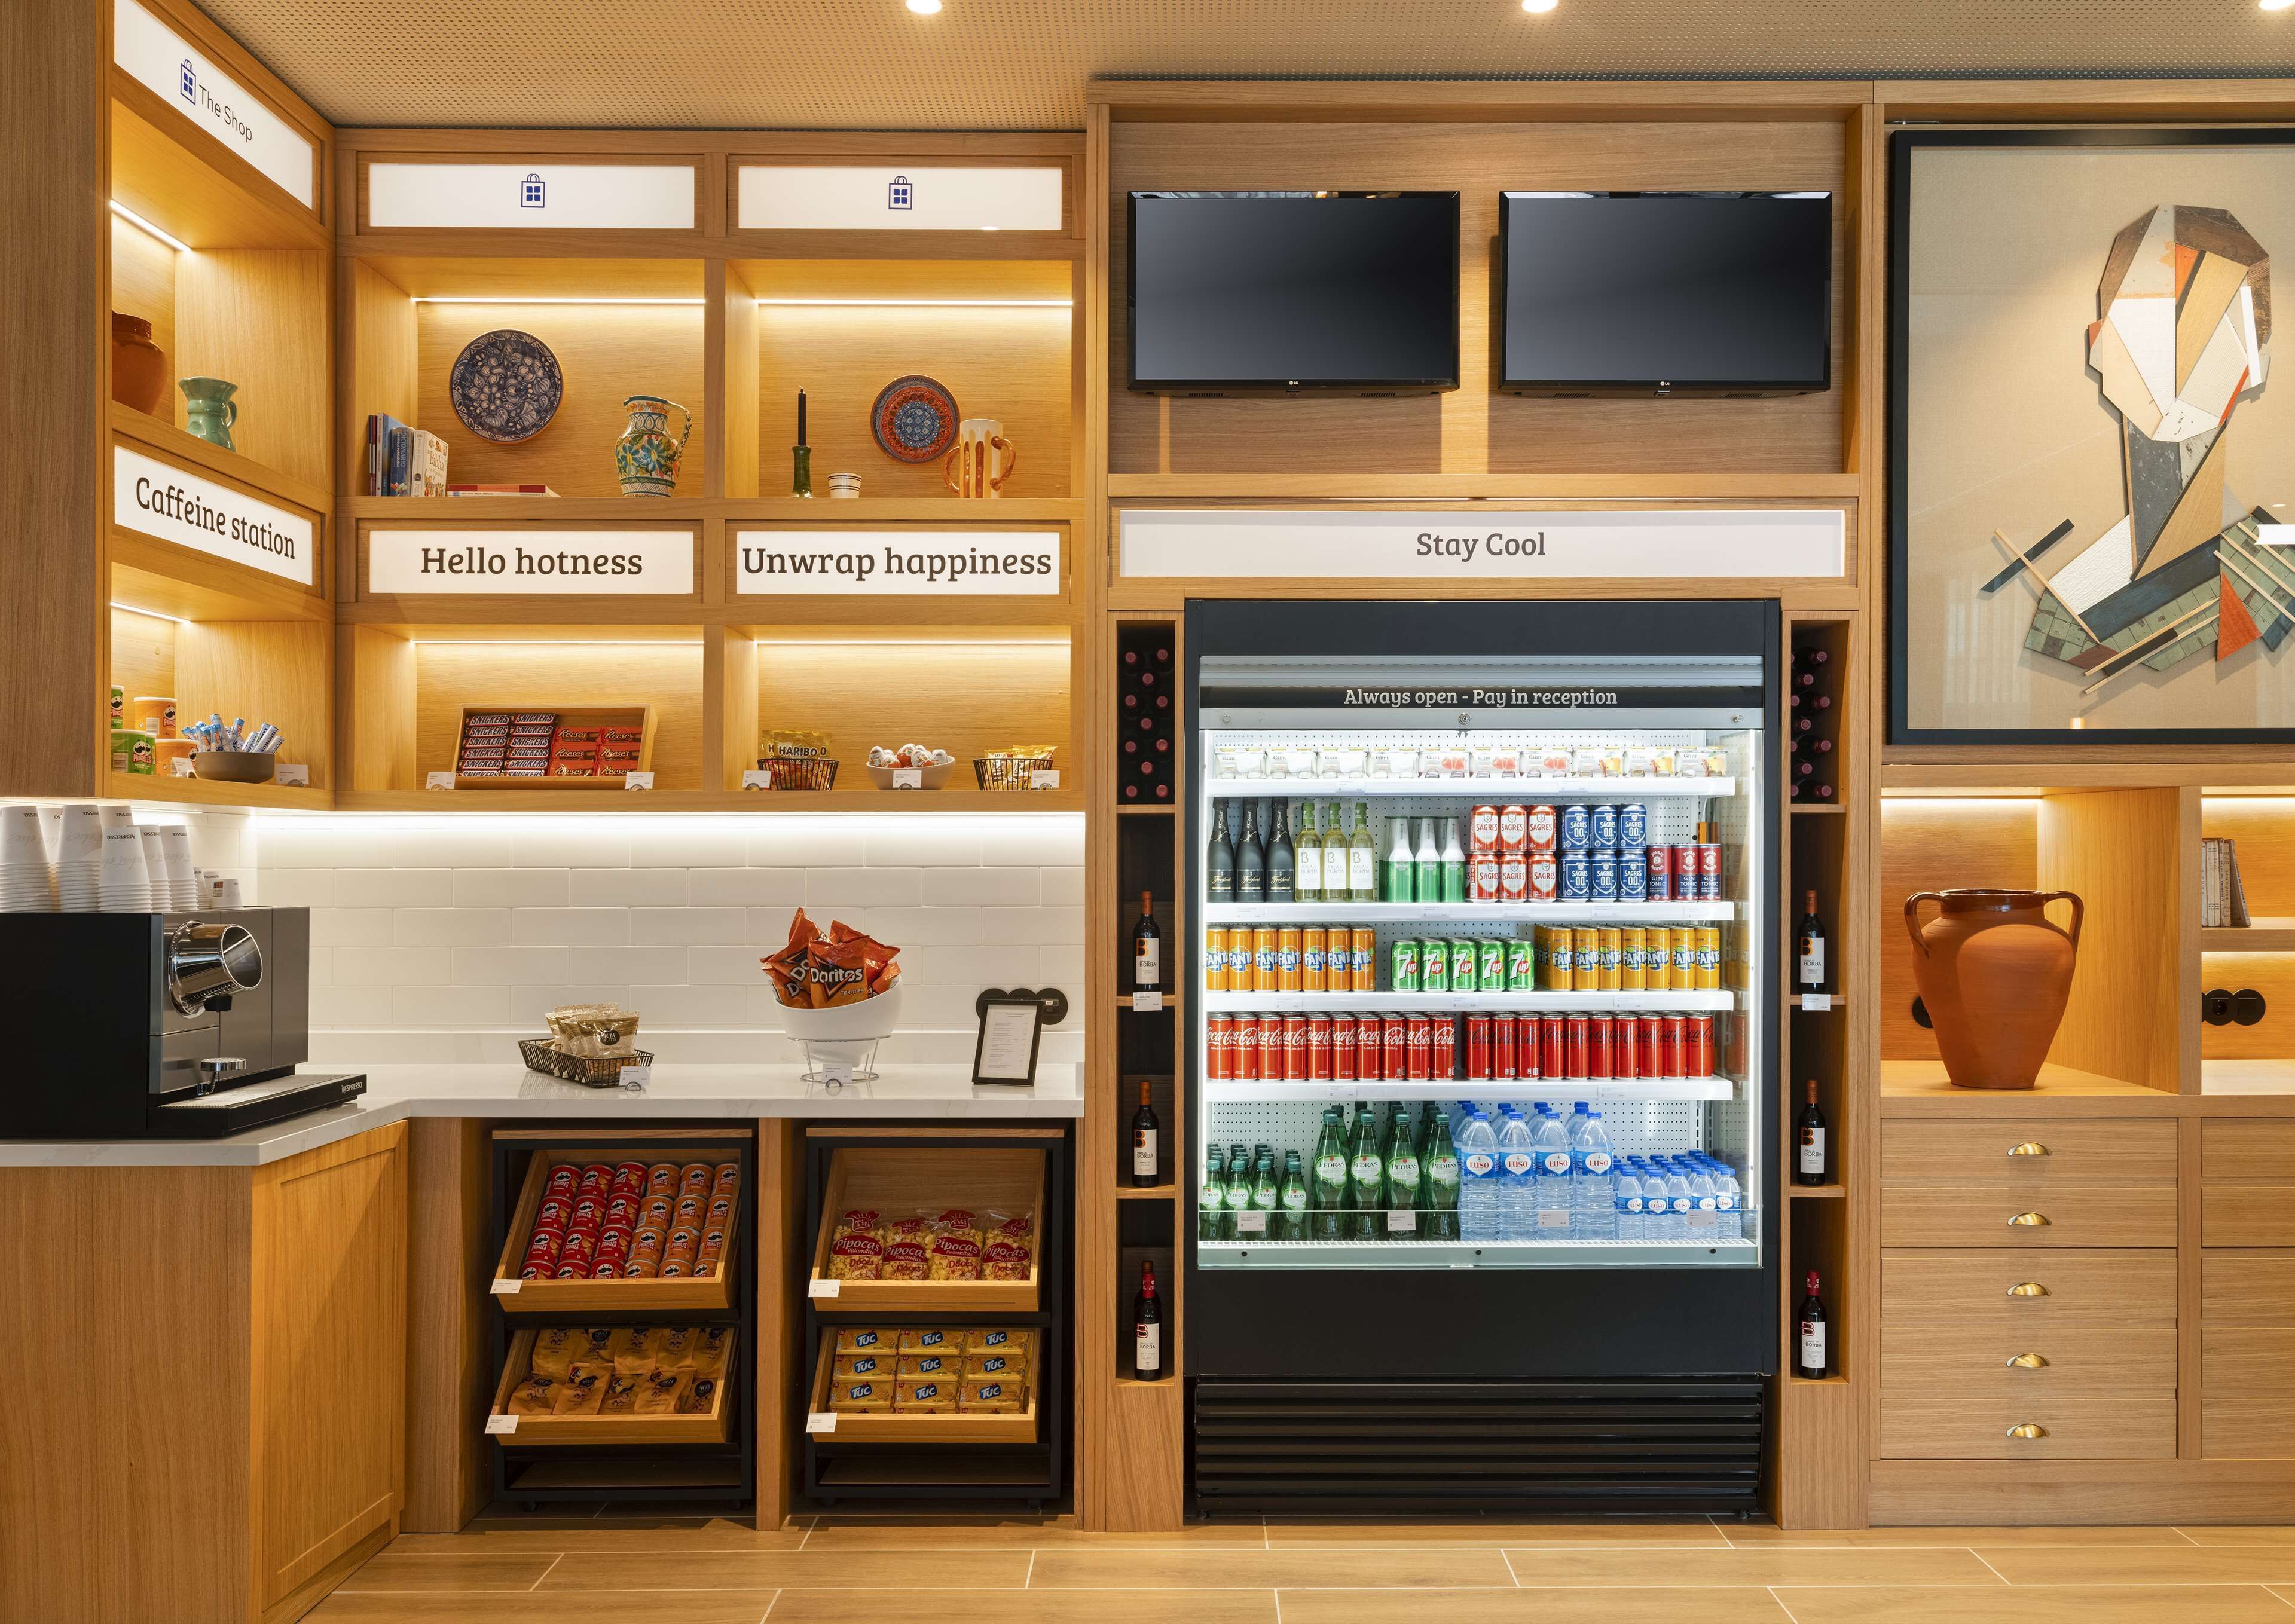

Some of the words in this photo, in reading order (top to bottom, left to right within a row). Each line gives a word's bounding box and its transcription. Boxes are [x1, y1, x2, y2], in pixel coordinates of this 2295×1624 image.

[199, 84, 222, 118] The
[224, 106, 253, 143] Shop
[136, 476, 226, 536] Caffeine
[231, 516, 295, 560] station
[1417, 533, 1479, 562] Stay
[1486, 532, 1545, 556] Cool
[421, 547, 505, 574] Hello
[515, 547, 642, 575] hotness
[743, 548, 875, 581] Unwrap
[884, 547, 1052, 582] happiness
[1344, 689, 1411, 707] Always
[1415, 692, 1457, 707] open
[1472, 690, 1506, 707] Pay
[1511, 689, 1528, 704] in
[1533, 689, 1617, 707] reception
[471, 715, 509, 724] SNICKERS
[517, 714, 554, 723] SNICKERS
[470, 726, 508, 736] SNICKERS
[468, 737, 507, 745] SNICKERS
[511, 737, 549, 746] SNICKERS
[778, 745, 818, 756] HARIBO
[464, 760, 503, 768] SNICKERS
[1534, 871, 1554, 880] SAGRES
[810, 967, 864, 984] Doritos
[341, 1082, 362, 1093] NESPRESSO
[837, 1238, 881, 1252] Pipocas
[934, 1239, 978, 1253] Pipocas
[885, 1246, 926, 1258] Pipocas
[985, 1246, 1025, 1258] Pipocas
[857, 1334, 876, 1347] TUC
[922, 1334, 942, 1345] TUC
[986, 1334, 1006, 1345] TUC
[855, 1360, 875, 1372] TUC
[921, 1360, 940, 1372] TUC
[985, 1360, 1004, 1371] TUC
[851, 1386, 870, 1398] TUC
[916, 1386, 936, 1400] TUC
[980, 1386, 1000, 1399] TUC
